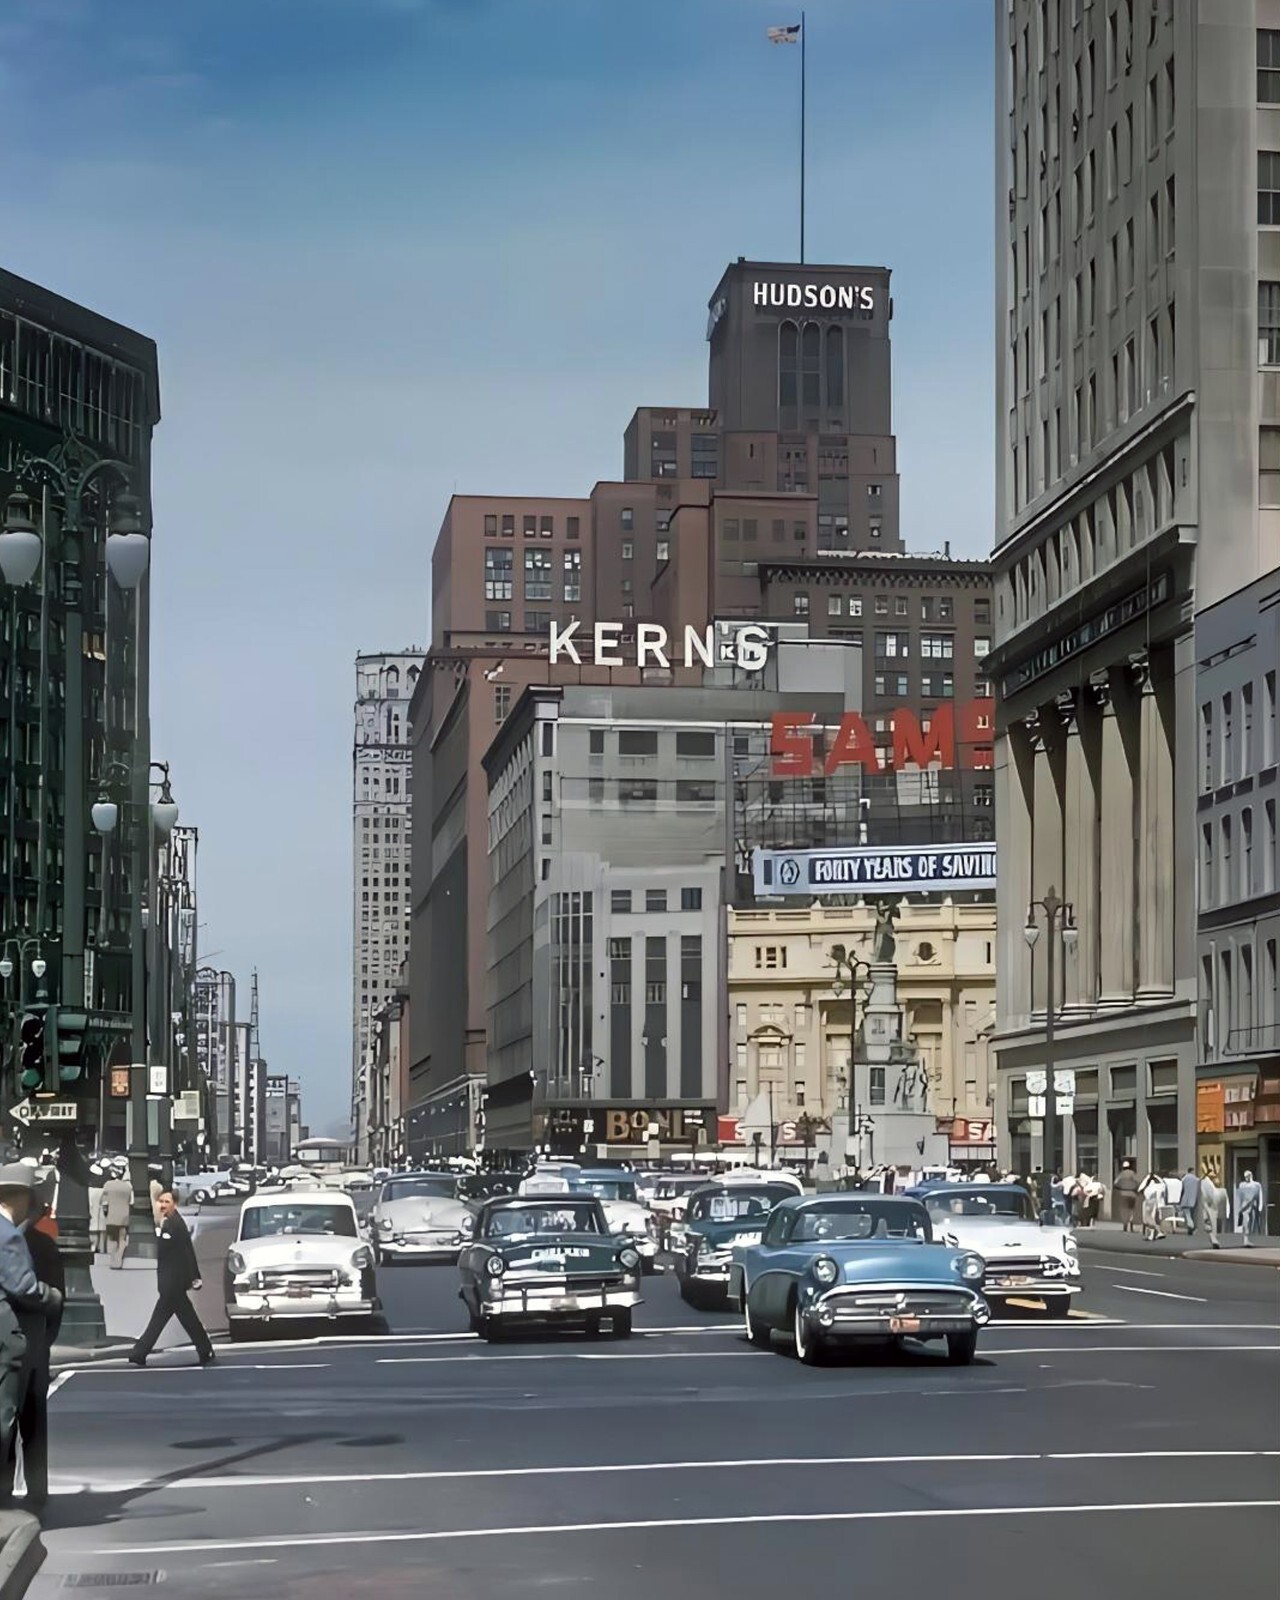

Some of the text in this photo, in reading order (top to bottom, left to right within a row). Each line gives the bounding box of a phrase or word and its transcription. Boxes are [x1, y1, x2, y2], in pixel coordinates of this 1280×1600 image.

[753, 282, 874, 310] HUDSON'S
[549, 621, 769, 670] KERN'S
[917, 855, 938, 877] OF
[942, 853, 997, 878] SAVIN
